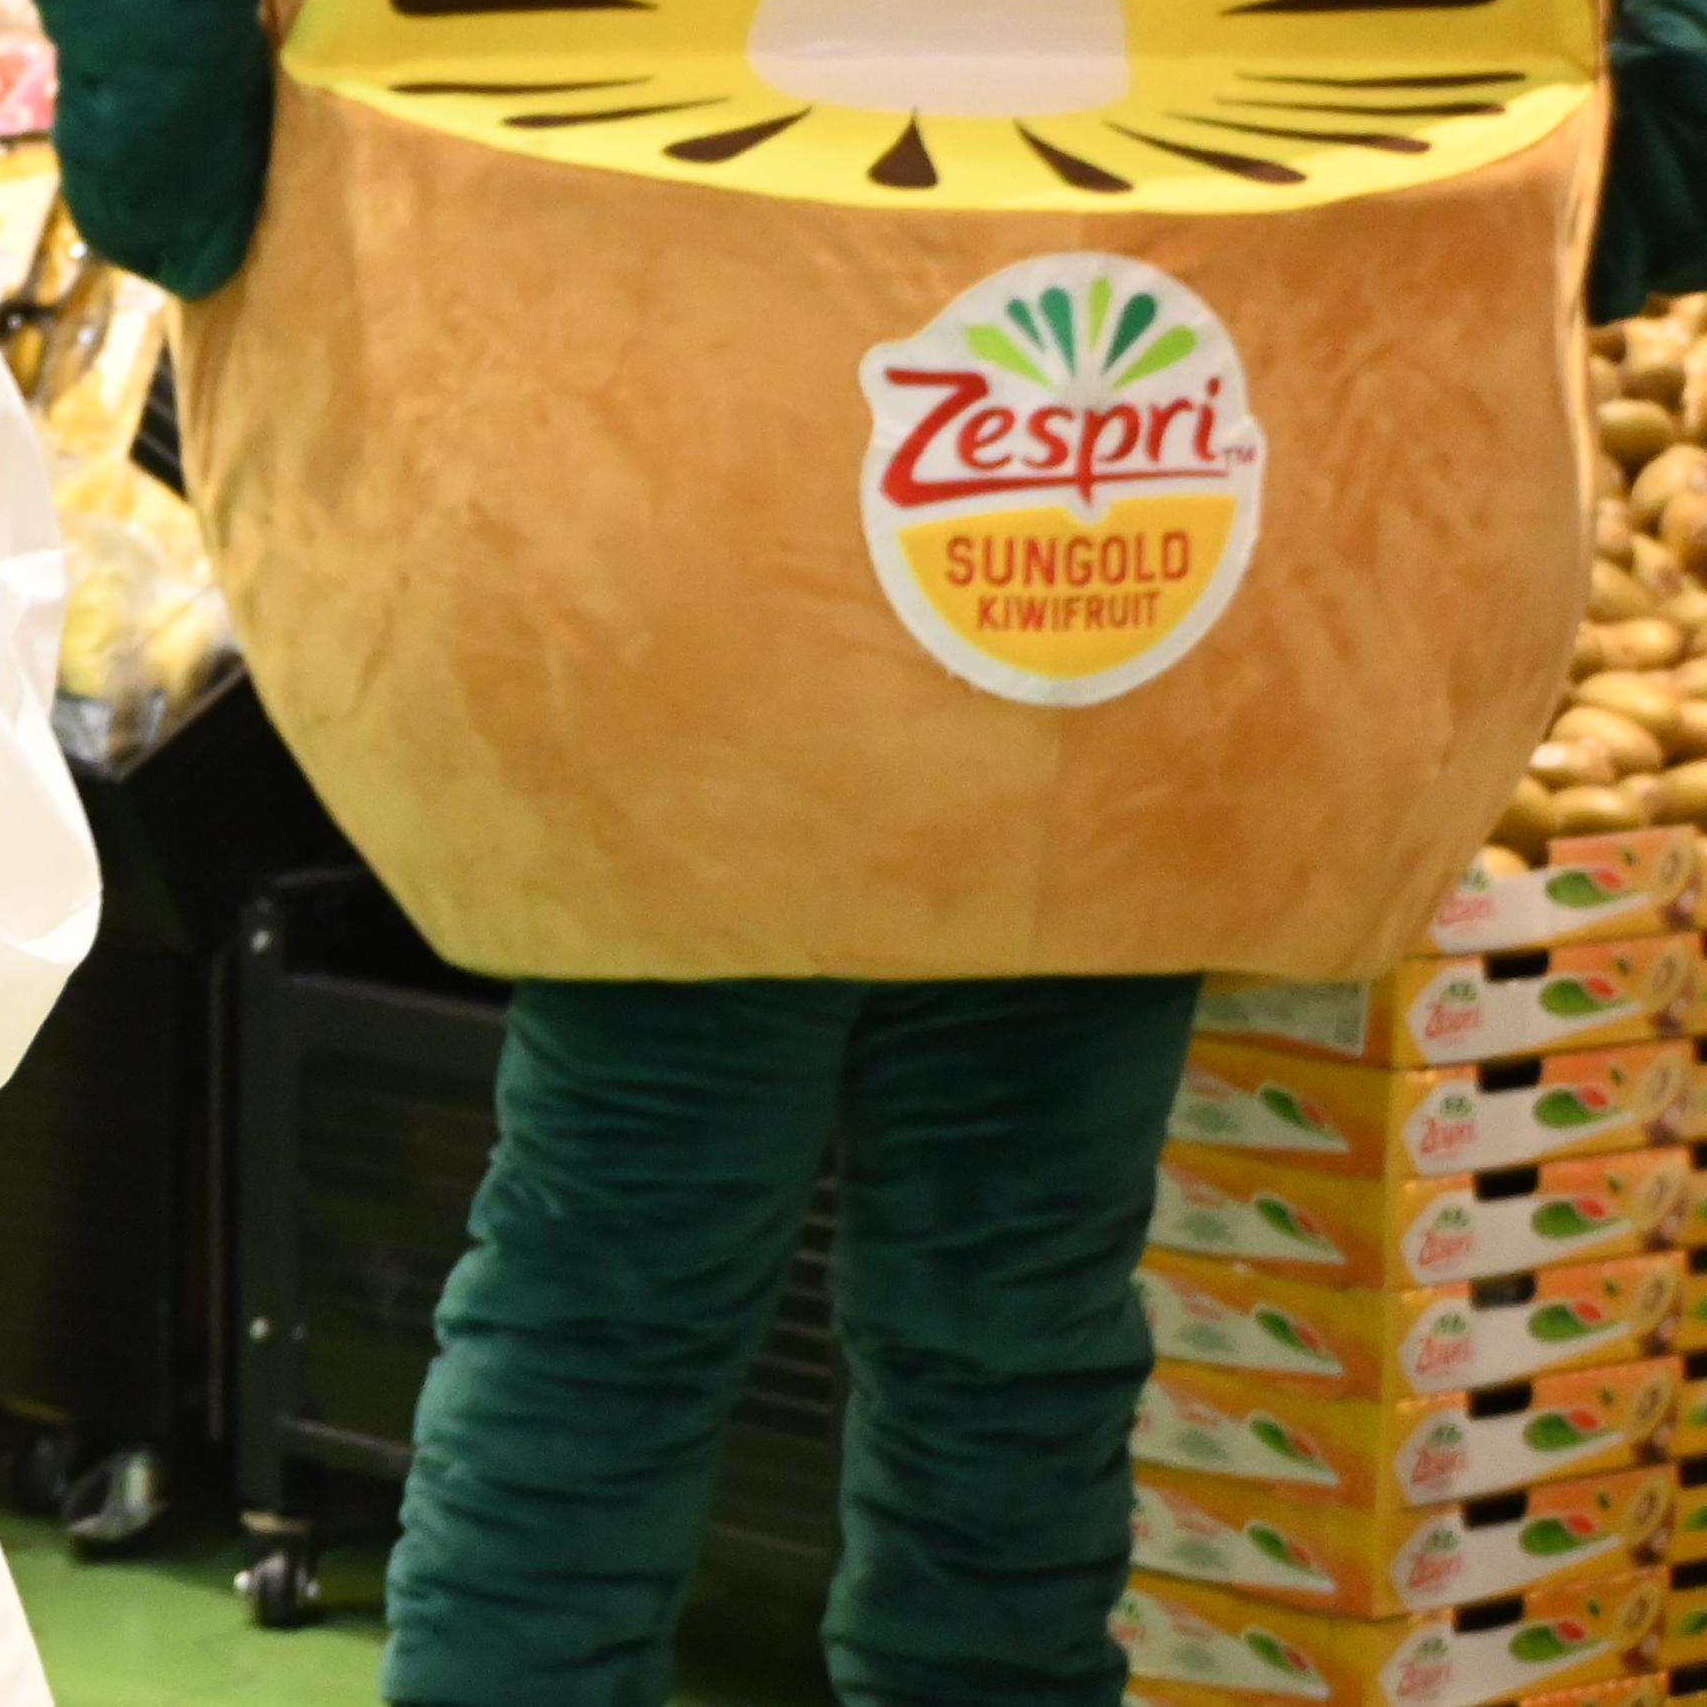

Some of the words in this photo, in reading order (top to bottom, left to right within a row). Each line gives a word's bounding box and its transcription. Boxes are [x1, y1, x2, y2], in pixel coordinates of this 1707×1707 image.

[881, 367, 1229, 508] Zespri
[946, 531, 1191, 587] SUNGOLD
[978, 592, 1161, 633] KIWIFRUIT
